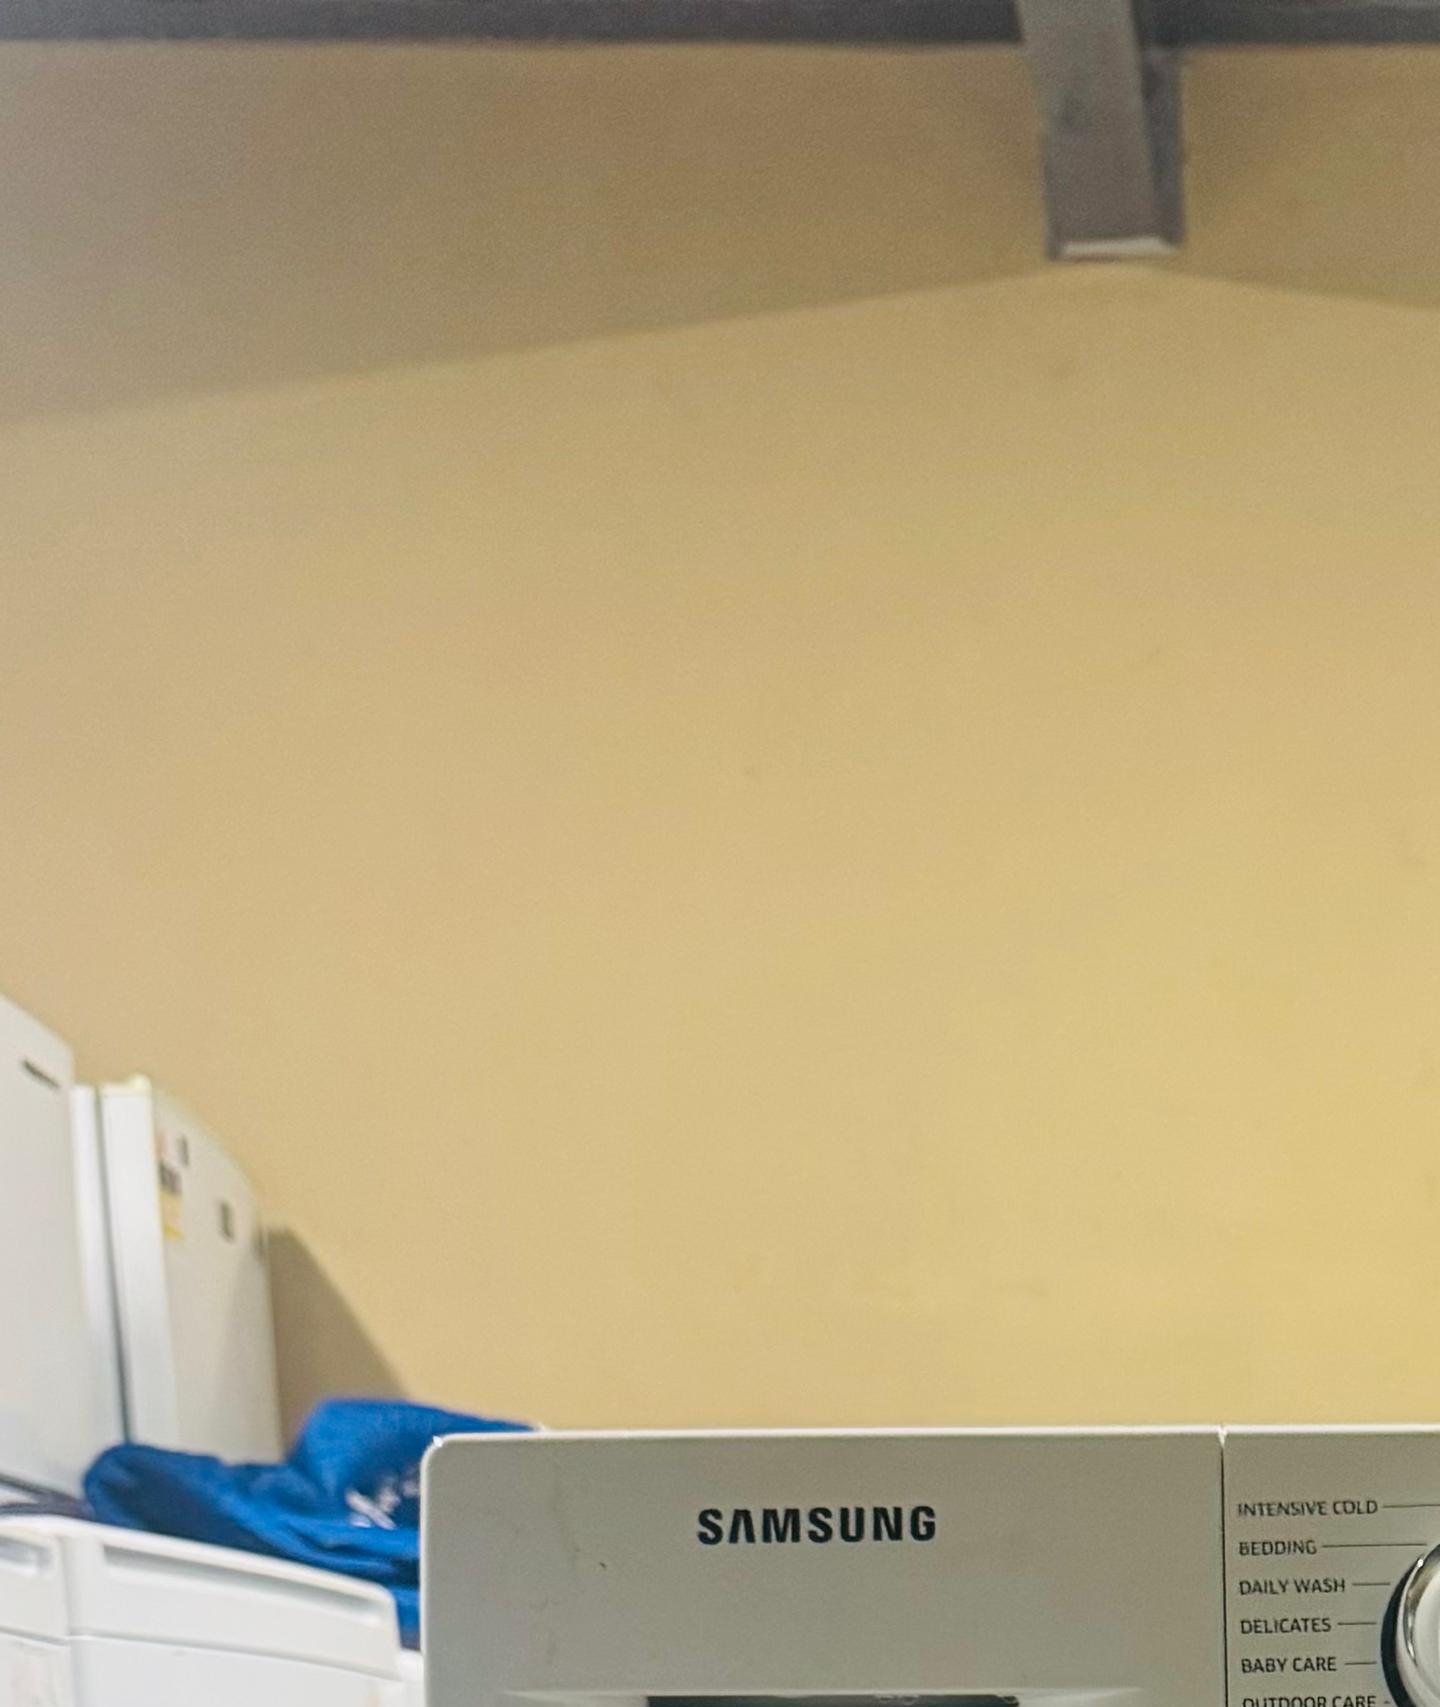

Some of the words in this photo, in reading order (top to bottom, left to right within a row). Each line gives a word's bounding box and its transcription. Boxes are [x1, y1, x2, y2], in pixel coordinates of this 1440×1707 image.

[1237, 1500, 1327, 1517] INTENSIVE
[1332, 1499, 1378, 1516] COLD
[697, 1505, 936, 1546] SAMSUNG
[1238, 1539, 1318, 1557] BEDDING
[1238, 1579, 1290, 1596] DAILY
[1293, 1577, 1346, 1594] WASH
[1239, 1617, 1332, 1635] DELICATES
[1240, 1657, 1288, 1674] BABY
[1292, 1656, 1337, 1673] CARE
